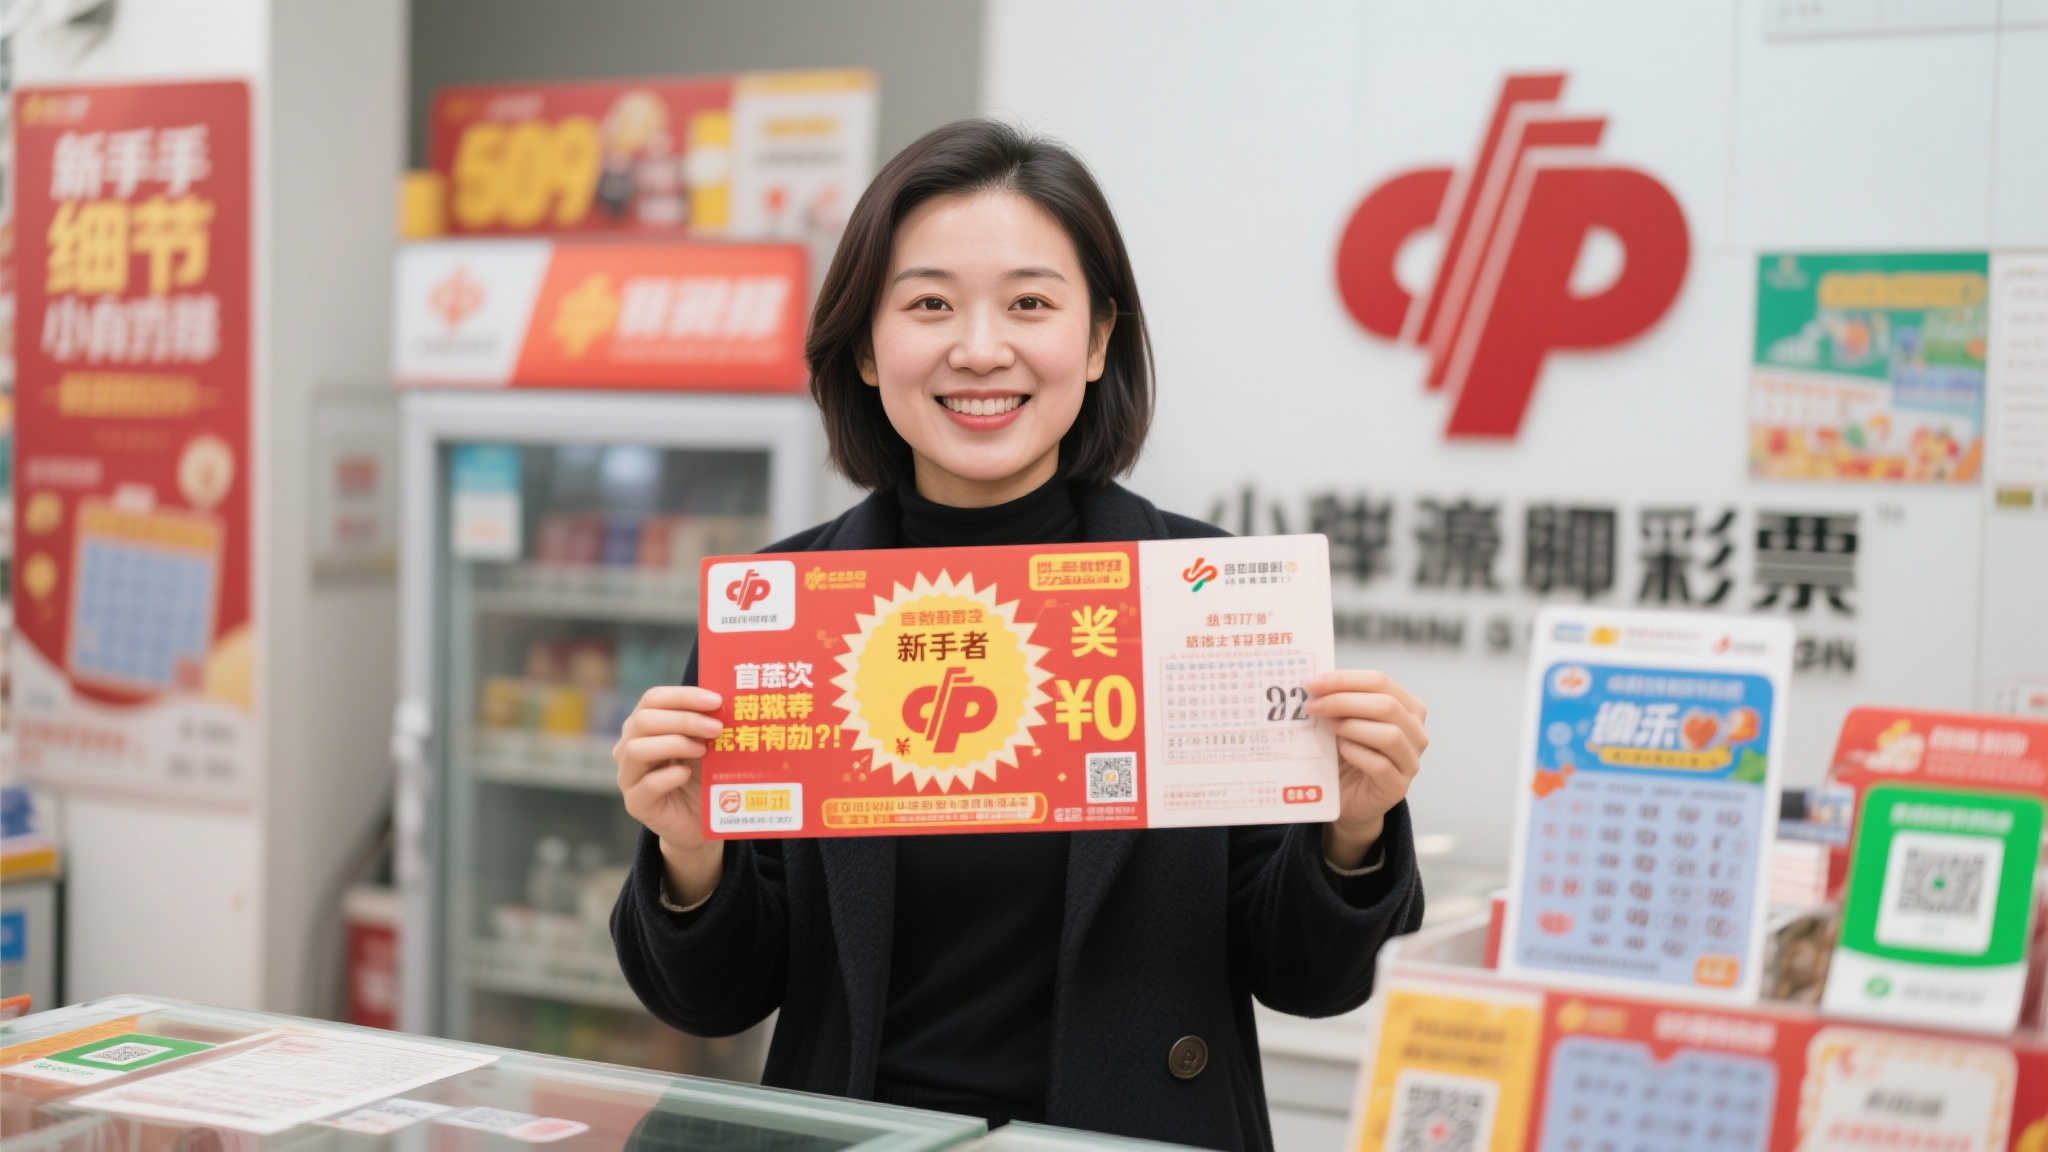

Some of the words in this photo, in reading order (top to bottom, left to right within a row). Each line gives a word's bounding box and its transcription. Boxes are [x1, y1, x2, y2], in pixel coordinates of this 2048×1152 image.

[46, 195, 215, 296] 细节
[897, 631, 990, 662] 新手者
[1054, 674, 1137, 741] ¥0
